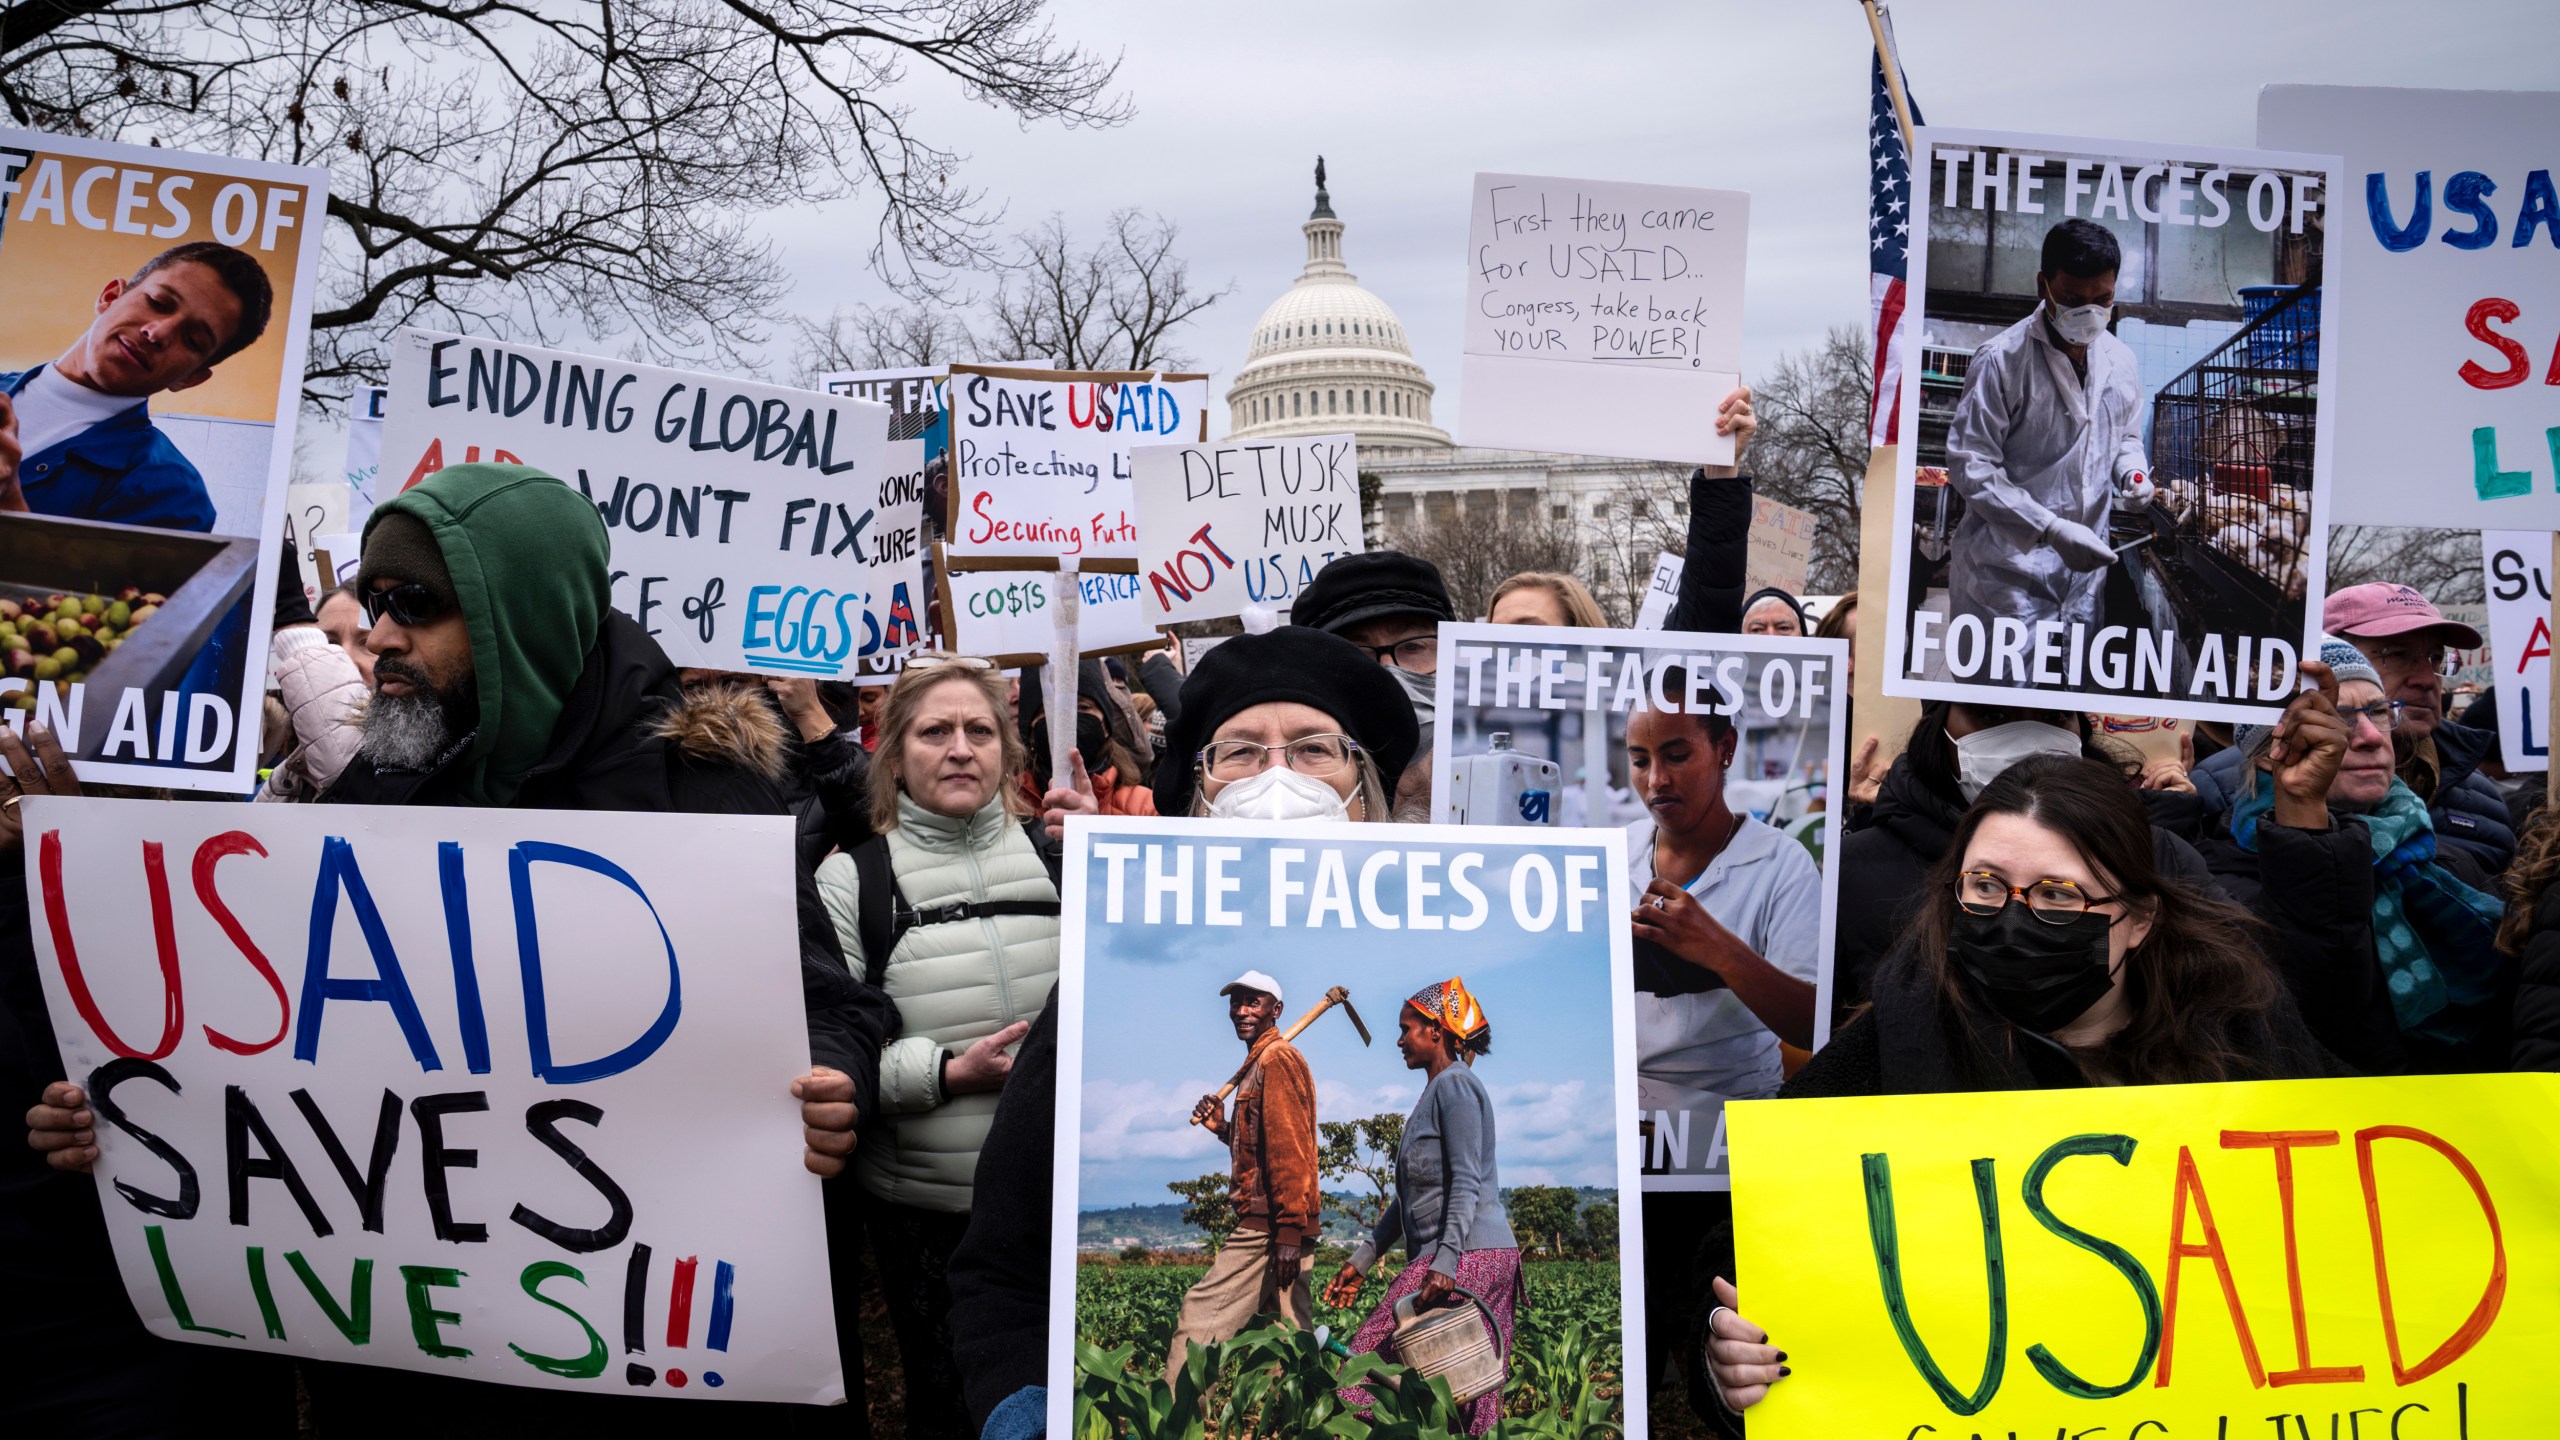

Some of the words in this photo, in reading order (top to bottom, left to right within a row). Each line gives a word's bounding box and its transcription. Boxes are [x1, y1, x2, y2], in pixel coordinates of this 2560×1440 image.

[211, 182, 300, 251] OF
[1491, 186, 1552, 240] First
[1570, 192, 1626, 252] they
[1641, 208, 1715, 231] came
[1935, 149, 2045, 215] THE
[2064, 159, 2232, 229] FACES
[2247, 172, 2319, 235] OF
[1480, 244, 1528, 283] for
[1481, 290, 1580, 326] Congress,
[1590, 291, 1638, 319] take
[1648, 294, 1708, 327] back
[1494, 328, 1568, 351] YOUR
[1592, 325, 1701, 367] POWER!
[427, 338, 637, 434] ENDING
[654, 382, 855, 476] GLOBAL
[967, 375, 1057, 431] SAVE
[1068, 382, 1181, 436] USAID
[347, 464, 379, 490] Mo
[779, 498, 875, 564] FIX
[969, 490, 1082, 554] Securing
[1264, 502, 1348, 548] MUSK
[1148, 522, 1236, 612] NOT
[1244, 551, 1354, 603] U.S.A
[1653, 566, 1682, 597] SU
[682, 576, 726, 644] of
[742, 585, 859, 663] EGGS
[1460, 646, 1567, 710] THE
[1587, 651, 1745, 717] FACES
[1760, 658, 1827, 719] OF
[1910, 609, 2174, 693] FOREIGN
[2190, 633, 2298, 702] AID
[102, 686, 233, 764] AID
[1094, 842, 1242, 926] THE
[1270, 848, 1489, 932] FACES
[1509, 852, 1600, 934] OF
[38, 828, 682, 1084] USAID
[87, 1057, 634, 1254] SAVES
[1860, 1124, 2508, 1417] USAID
[142, 1224, 736, 1389] LIVES!!!
